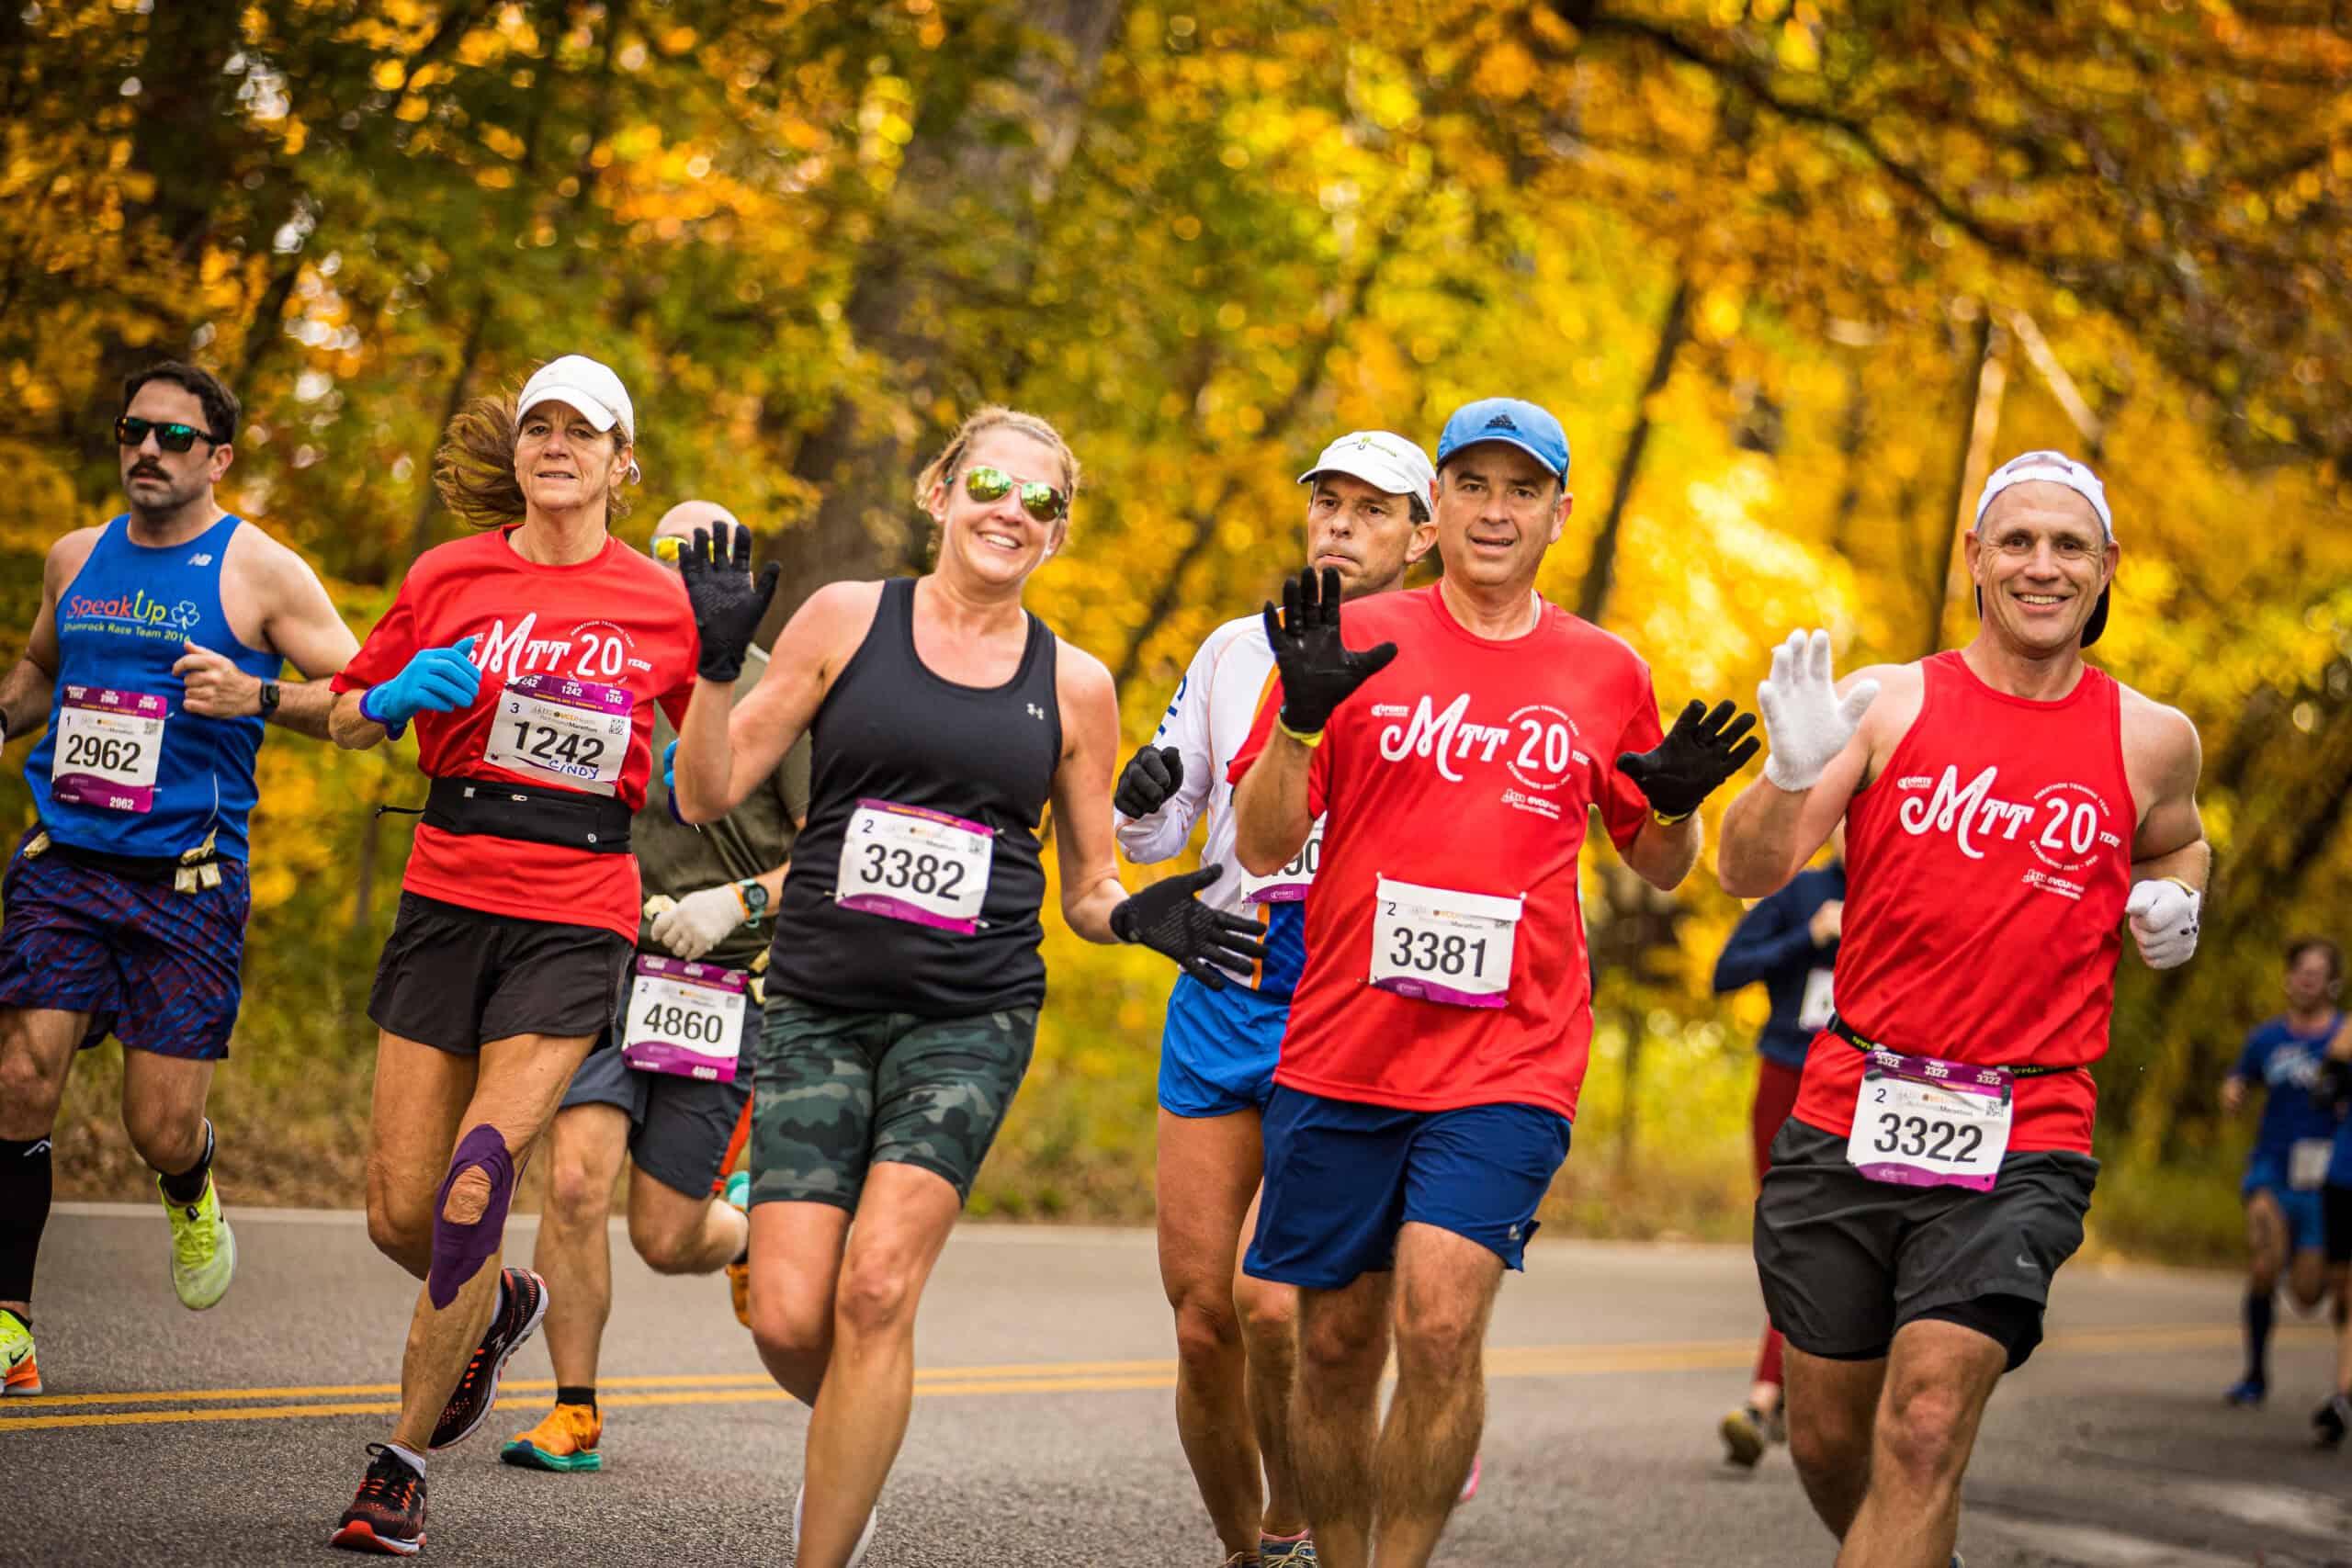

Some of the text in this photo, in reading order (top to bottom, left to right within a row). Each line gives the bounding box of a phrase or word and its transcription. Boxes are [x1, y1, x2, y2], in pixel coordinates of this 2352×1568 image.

[107, 623, 132, 634] Race
[135, 626, 161, 638] Team
[576, 633, 624, 677] 20
[627, 658, 652, 672] YEARS
[561, 685, 583, 697] 1242
[510, 703, 520, 714] 3
[66, 714, 72, 727] 1
[514, 721, 605, 769] 1242
[1379, 693, 1569, 783] MTT 20
[65, 734, 141, 773] 2962
[548, 759, 600, 780] CINDY
[1899, 764, 2098, 860] MTT 20
[862, 818, 875, 834] 2
[860, 843, 965, 901] 3382
[1386, 901, 1396, 917] 2
[1390, 927, 1487, 977] 3381
[640, 982, 649, 993] 2
[643, 1002, 724, 1043] 4860
[1925, 1065, 1949, 1078] 3322
[1976, 1074, 2002, 1085] 3322
[1874, 1088, 1887, 1103] 2
[1874, 1112, 1983, 1164] 3322
